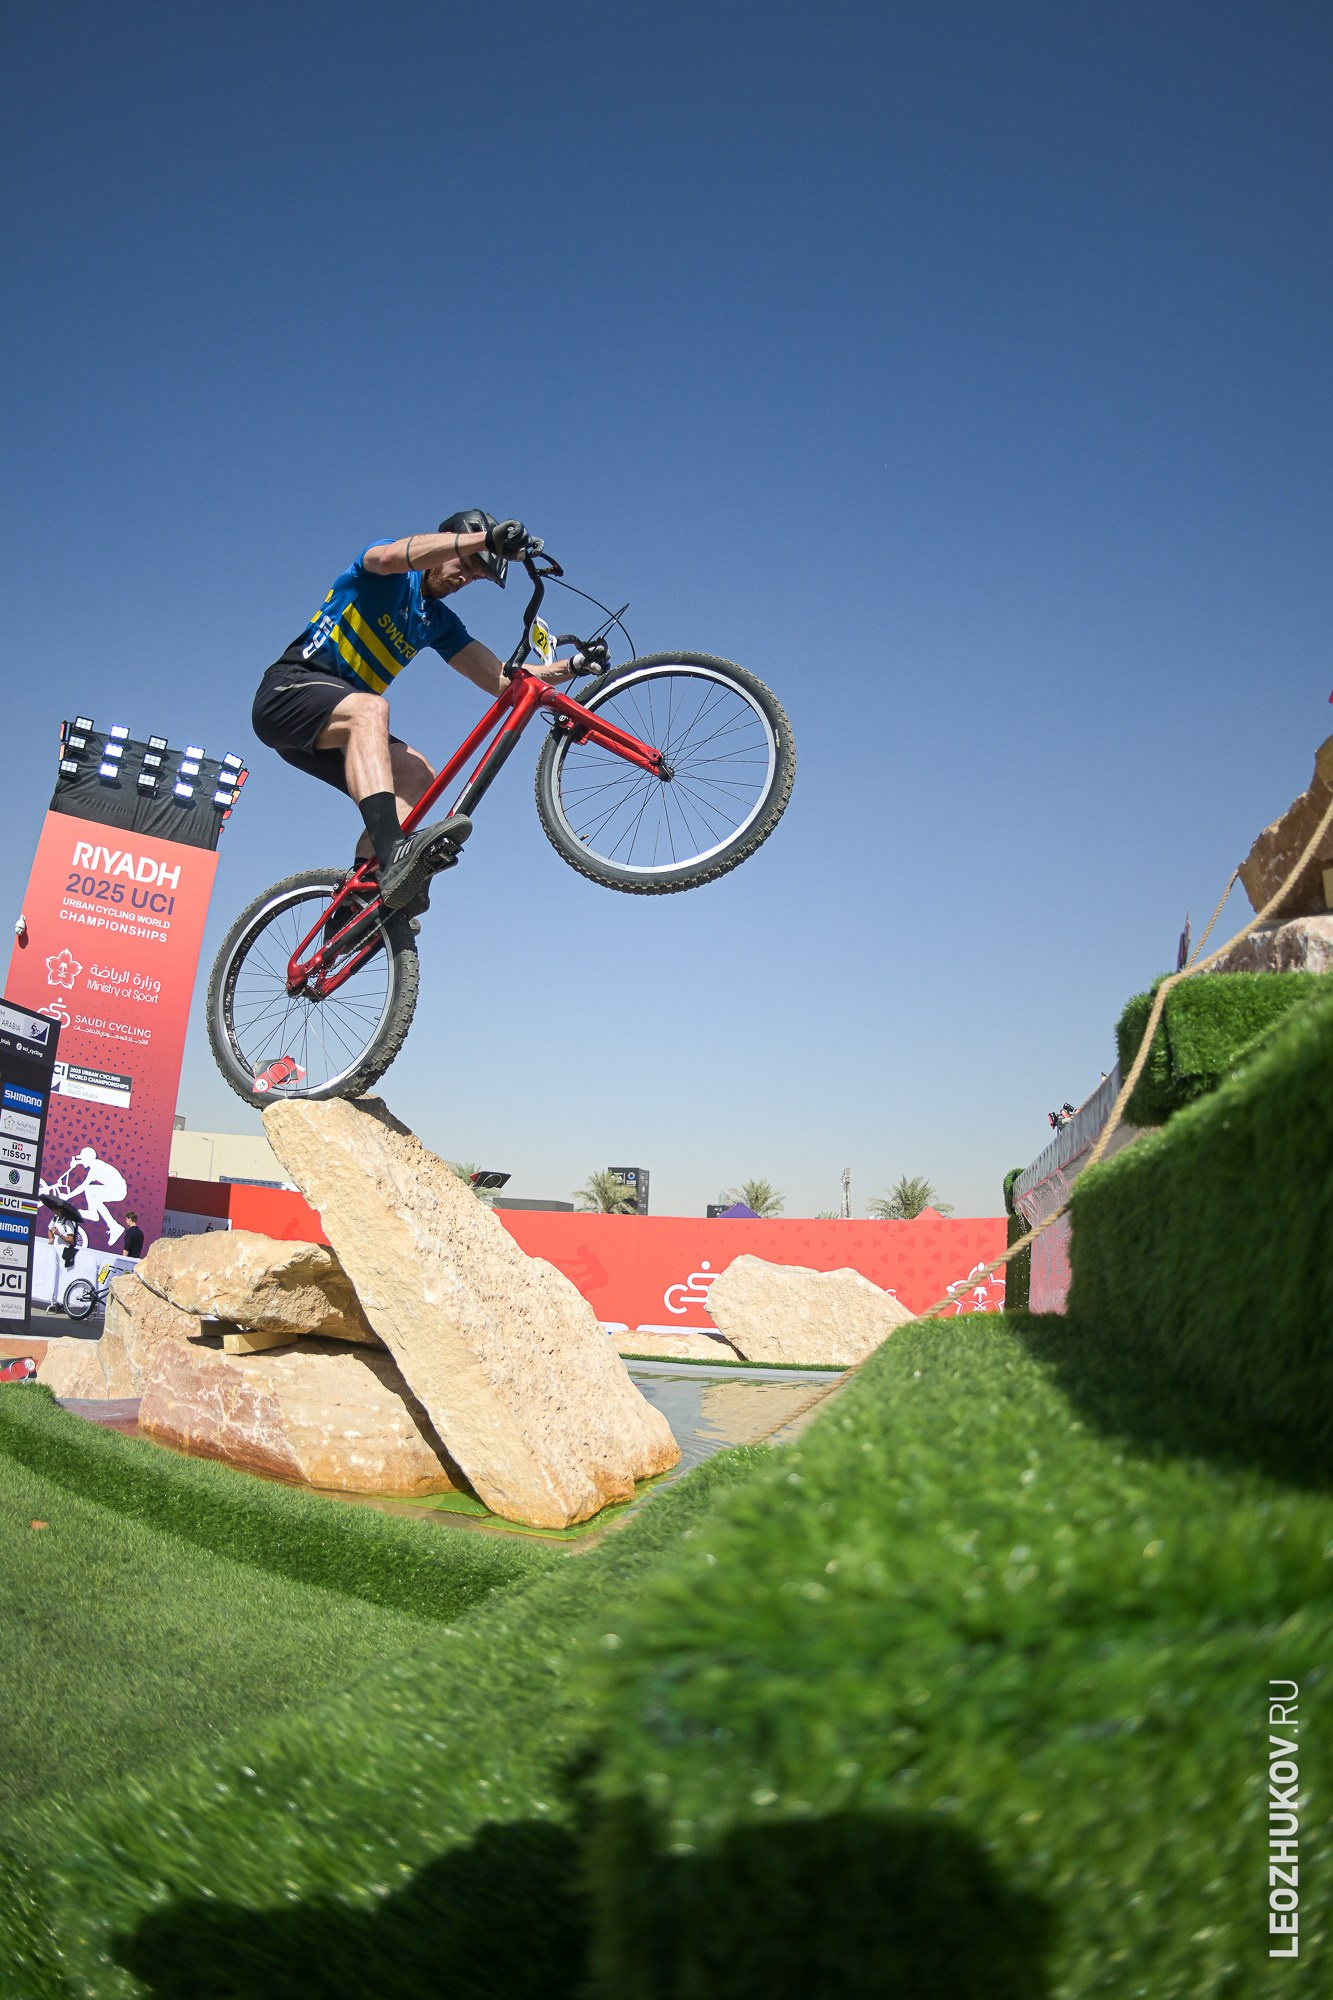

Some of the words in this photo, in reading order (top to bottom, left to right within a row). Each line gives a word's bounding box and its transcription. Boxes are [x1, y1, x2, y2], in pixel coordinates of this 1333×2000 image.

[72, 841, 182, 890] RIYADH
[65, 873, 126, 904] 2025
[131, 887, 175, 916] UCI
[62, 897, 95, 912] URBAN
[95, 904, 136, 922] CYCLING
[137, 914, 171, 930] WORLD
[59, 909, 168, 943] CHAMPIONSHIPS
[90, 963, 131, 985] الرياضة
[132, 973, 161, 993] وزارة
[86, 979, 121, 998] Ministry
[121, 988, 132, 998] of
[132, 989, 159, 1004] Sport
[74, 1014, 106, 1029] SAUDI
[108, 1022, 152, 1039] CYCLING
[53, 1064, 66, 1076] CI
[81, 1069, 99, 1078] URBAN
[99, 1073, 121, 1083] CYCLING
[69, 1072, 88, 1082] WORLD
[87, 1076, 130, 1090] CHAMPIONSHIPS
[4, 1089, 43, 1108] SHIMANO
[2, 1147, 32, 1161] TISSOT
[3, 1197, 20, 1209] UCI
